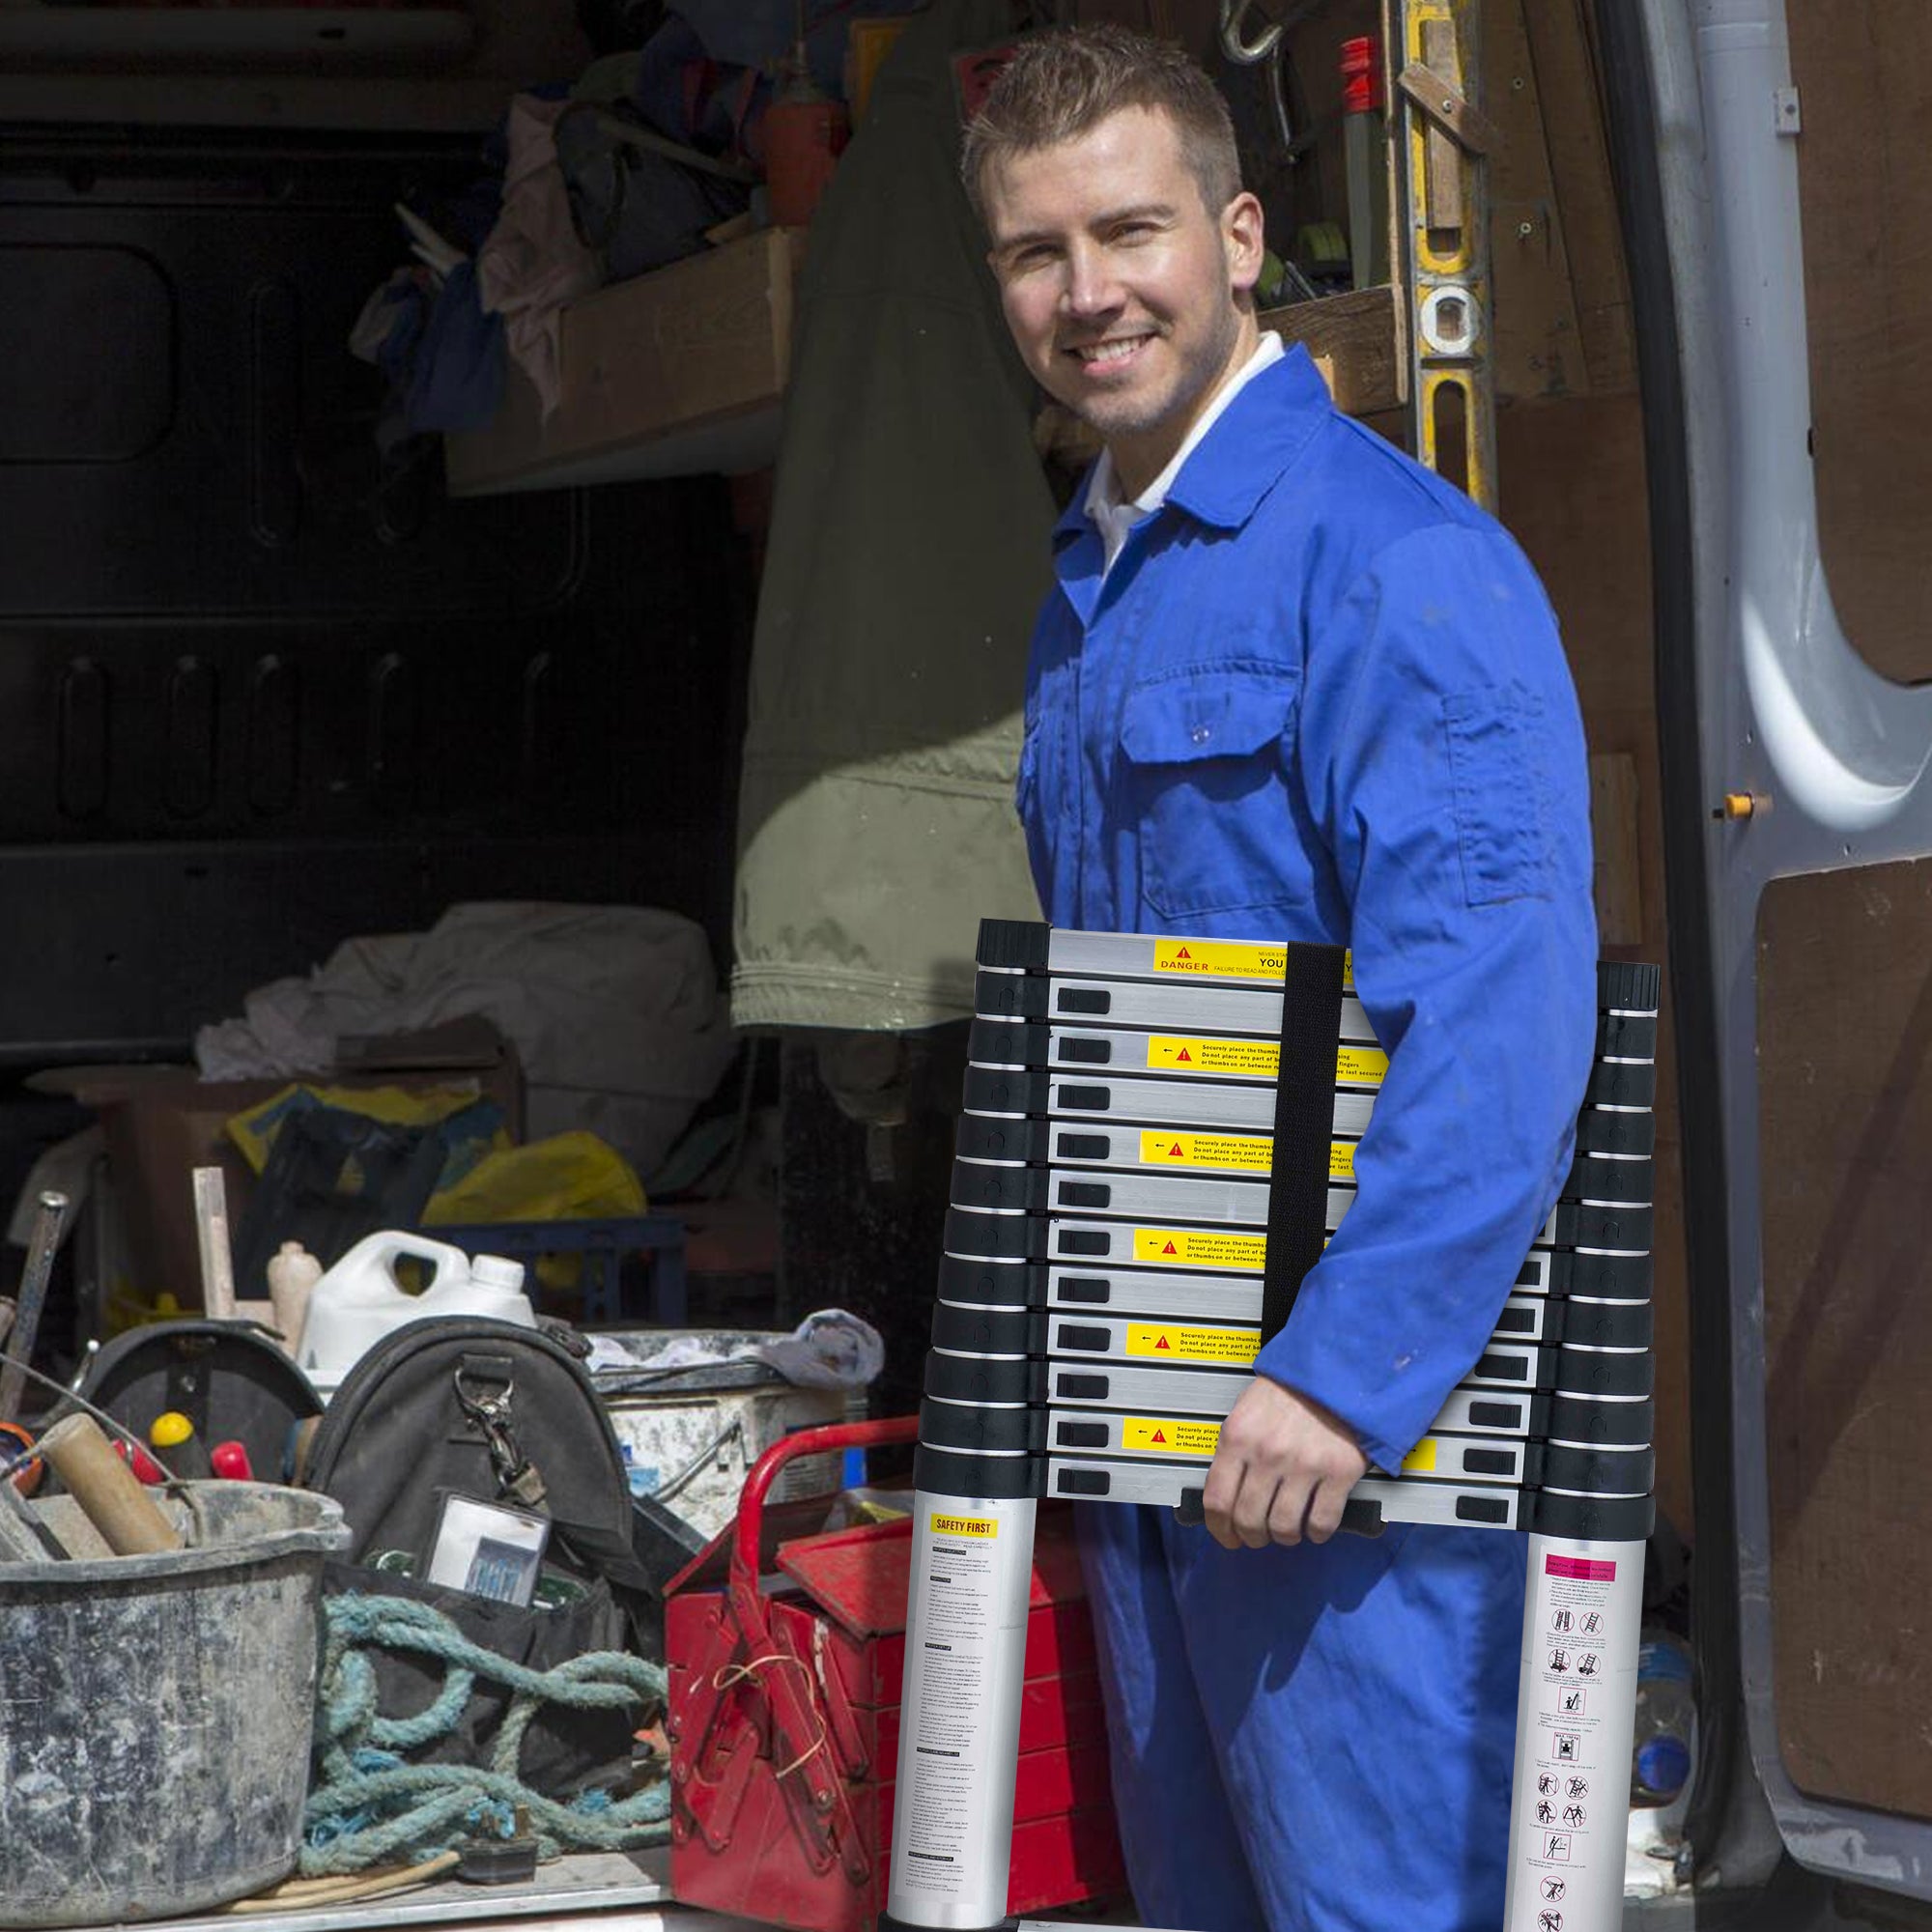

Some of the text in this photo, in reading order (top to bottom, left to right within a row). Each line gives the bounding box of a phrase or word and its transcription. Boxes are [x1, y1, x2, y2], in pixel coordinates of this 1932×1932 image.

[1161, 960, 1208, 971] DANGER
[1260, 958, 1283, 968] YOU
[937, 1519, 991, 1533] SAFETY FIRST
